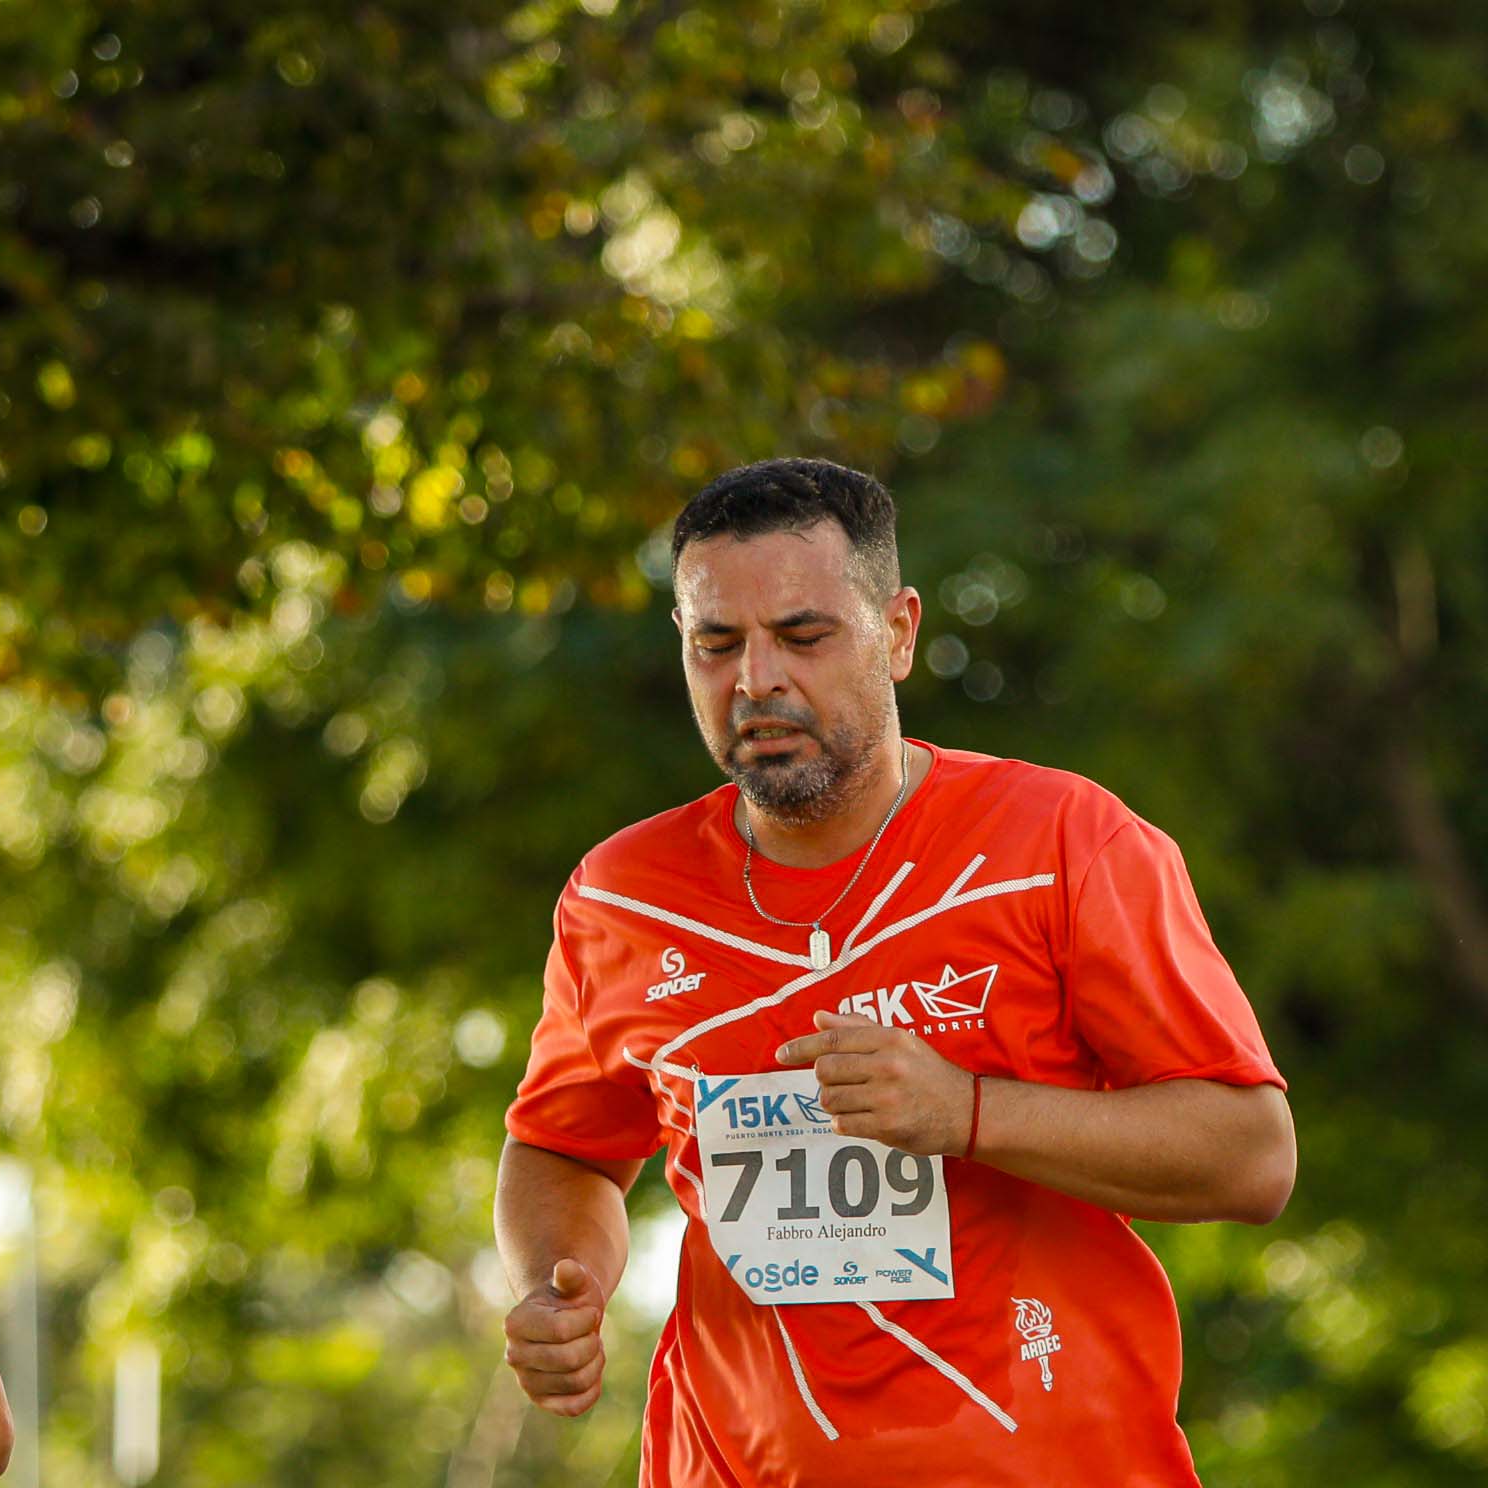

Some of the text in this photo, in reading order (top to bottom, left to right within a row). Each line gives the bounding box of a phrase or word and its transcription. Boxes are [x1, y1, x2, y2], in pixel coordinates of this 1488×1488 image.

[923, 1018, 985, 1035] NORTE
[721, 1093, 792, 1129] 15K
[758, 1130, 783, 1138] NORTE
[711, 1145, 935, 1222] 7109
[767, 1223, 887, 1242] Fabbro Alejandro
[744, 1258, 820, 1289] osde
[875, 1268, 913, 1277] POWER
[1020, 1334, 1062, 1361] ARDEC
